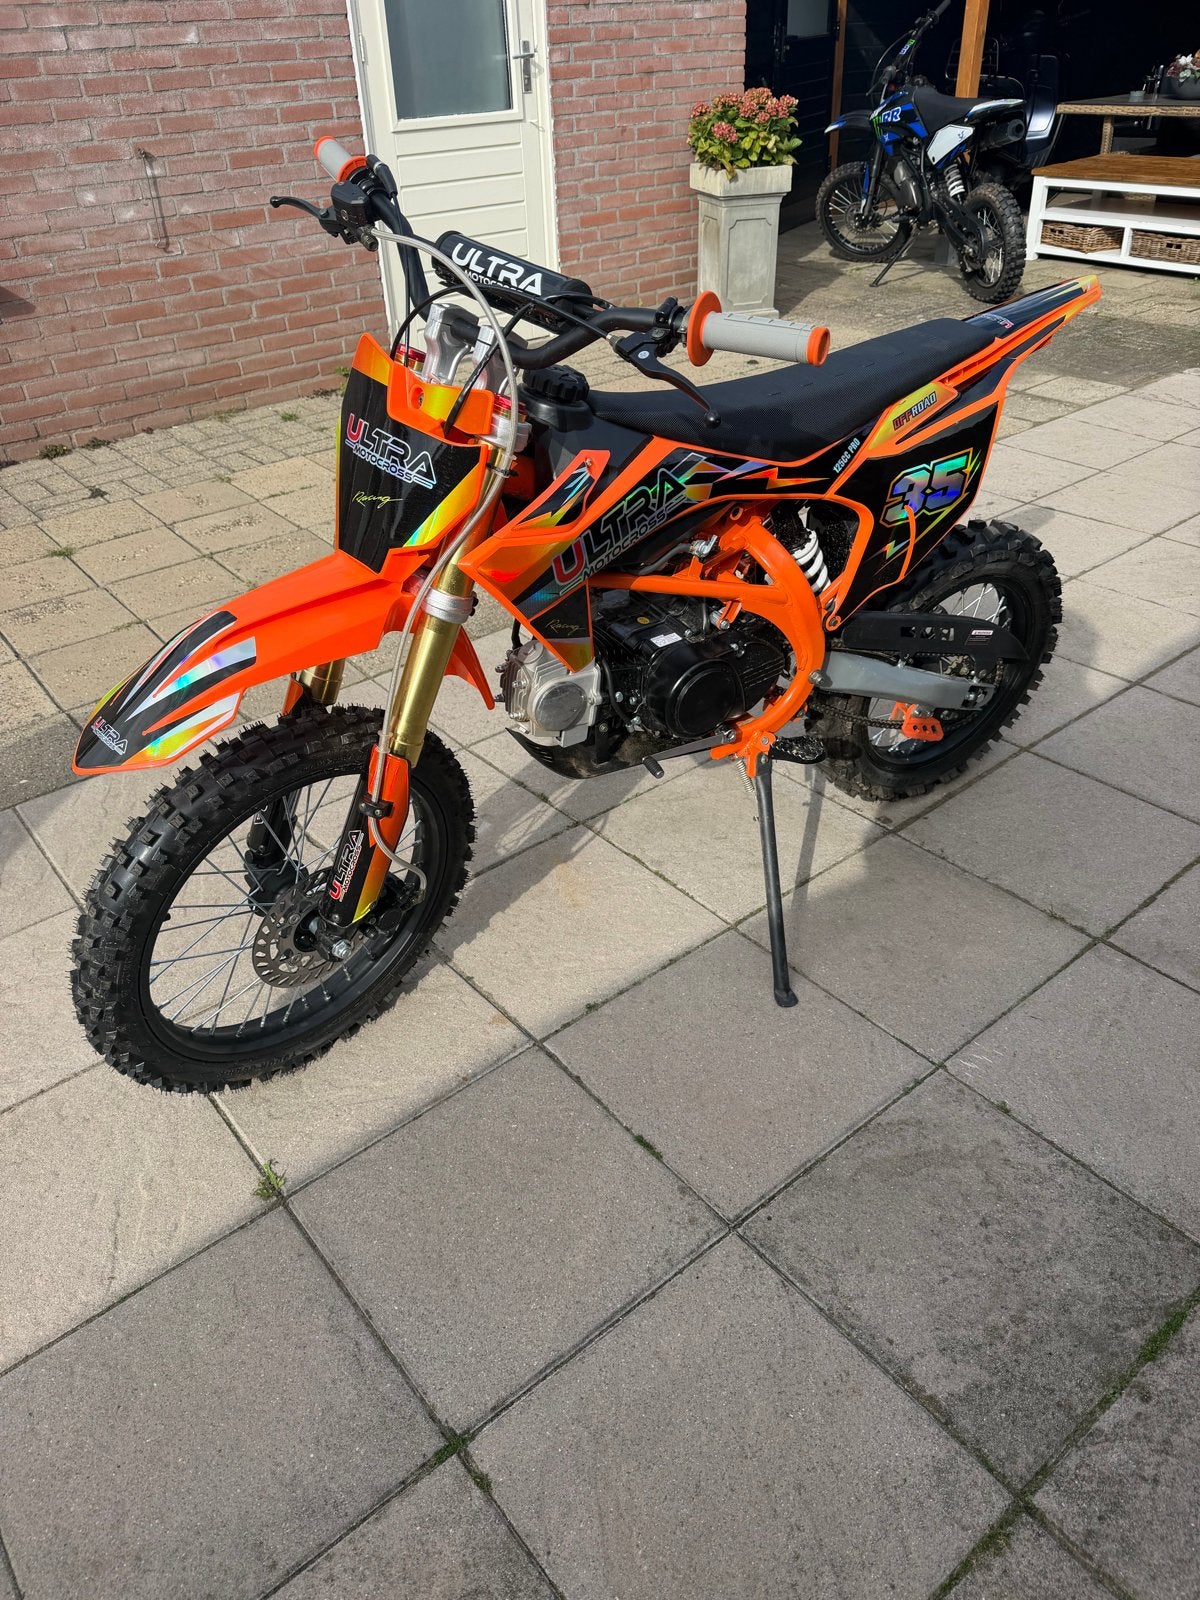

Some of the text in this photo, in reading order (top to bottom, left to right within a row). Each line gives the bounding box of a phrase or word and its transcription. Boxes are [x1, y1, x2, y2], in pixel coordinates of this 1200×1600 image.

[451, 242, 542, 296] ULTRA
[893, 391, 937, 430] OFFROAD
[346, 412, 437, 485] ULTRA
[352, 444, 414, 484] MOTOCROSS
[833, 437, 861, 474] 125CC PRO
[352, 491, 403, 508] Racing
[883, 451, 970, 525] 35
[552, 468, 687, 586] ULTRA
[581, 511, 667, 582] MOTOCROSS
[93, 716, 128, 754] ULTRA
[329, 829, 362, 900] ULTRA
